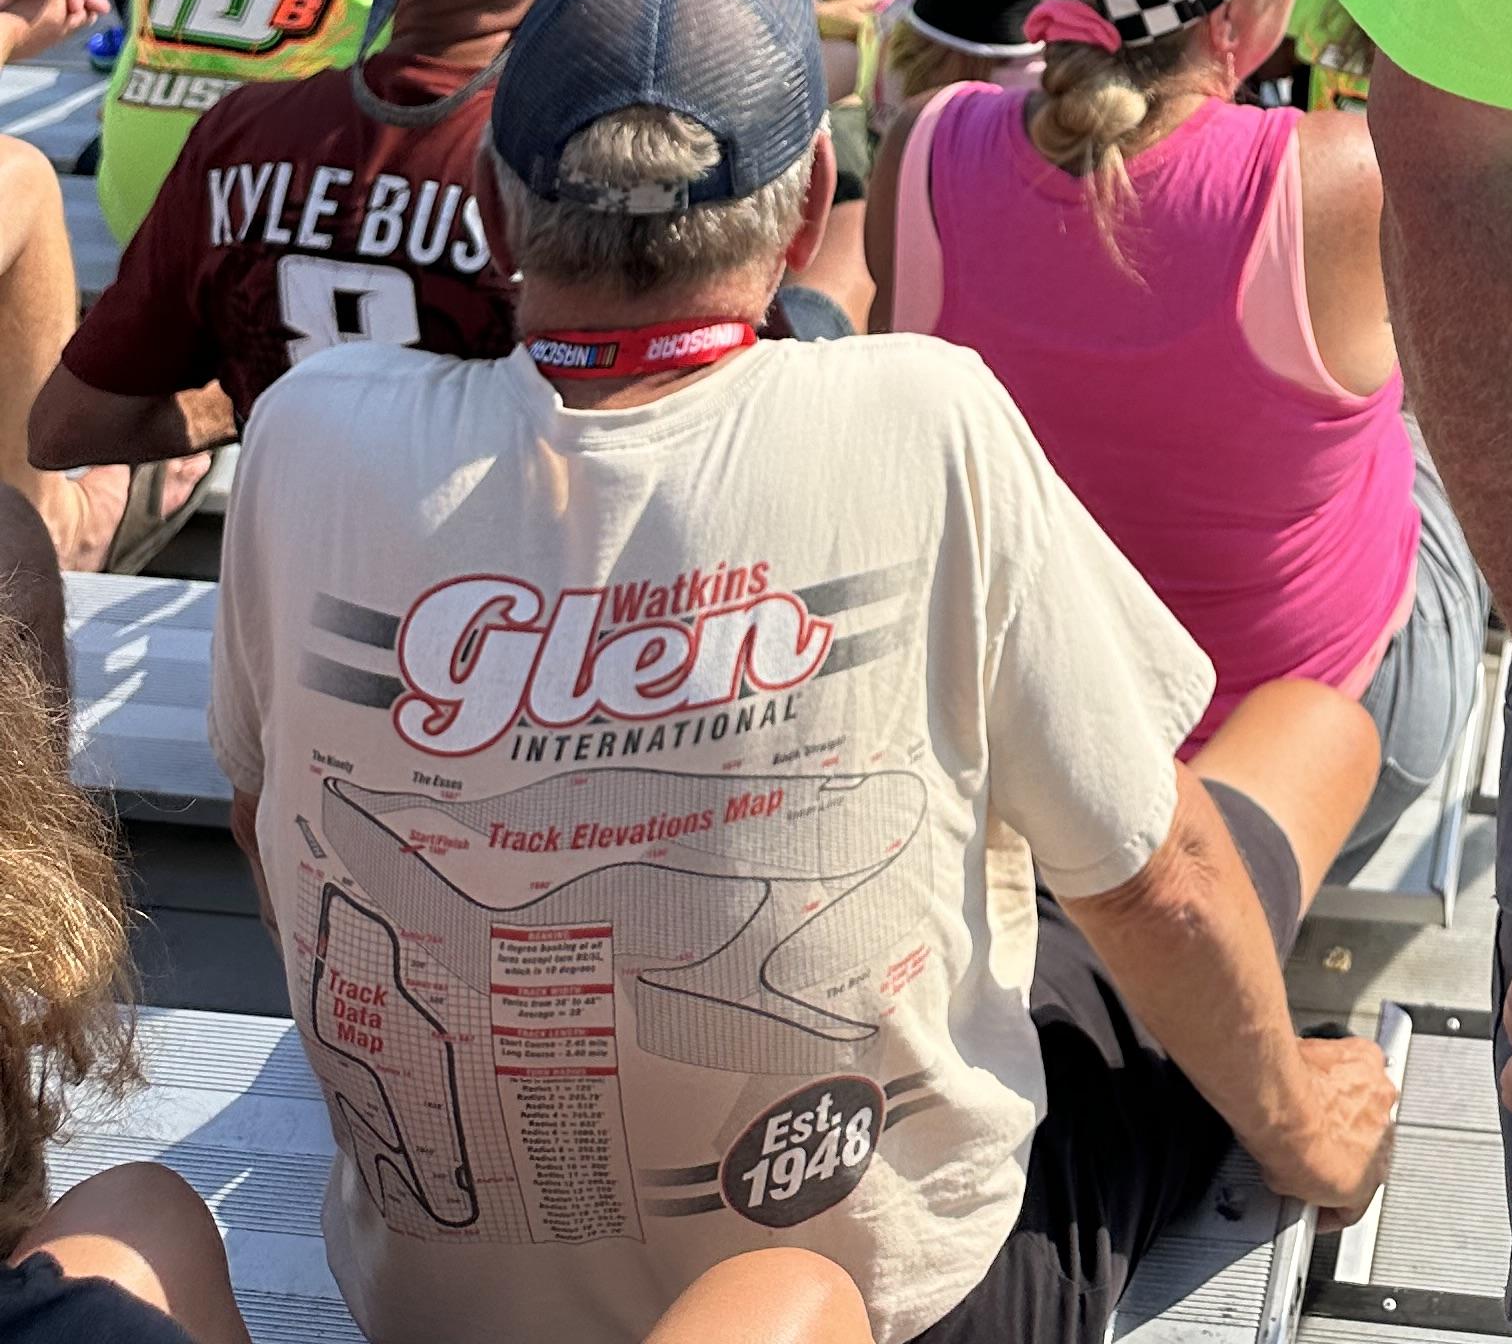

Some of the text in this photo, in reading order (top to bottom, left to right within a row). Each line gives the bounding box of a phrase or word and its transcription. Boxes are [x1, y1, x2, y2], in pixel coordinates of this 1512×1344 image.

[118, 64, 245, 112] BUS
[208, 161, 354, 250] KYLE
[647, 323, 737, 361] NASCAR
[607, 560, 771, 627] Watkins
[510, 695, 799, 762] INTERNATIONAL
[412, 770, 431, 786] The
[488, 786, 785, 853] Track Elevations Map
[329, 967, 389, 1007] Track
[333, 996, 383, 1030] Data
[337, 1021, 385, 1054] Map
[762, 1092, 842, 1156] Est.
[742, 1107, 873, 1209] 1948
